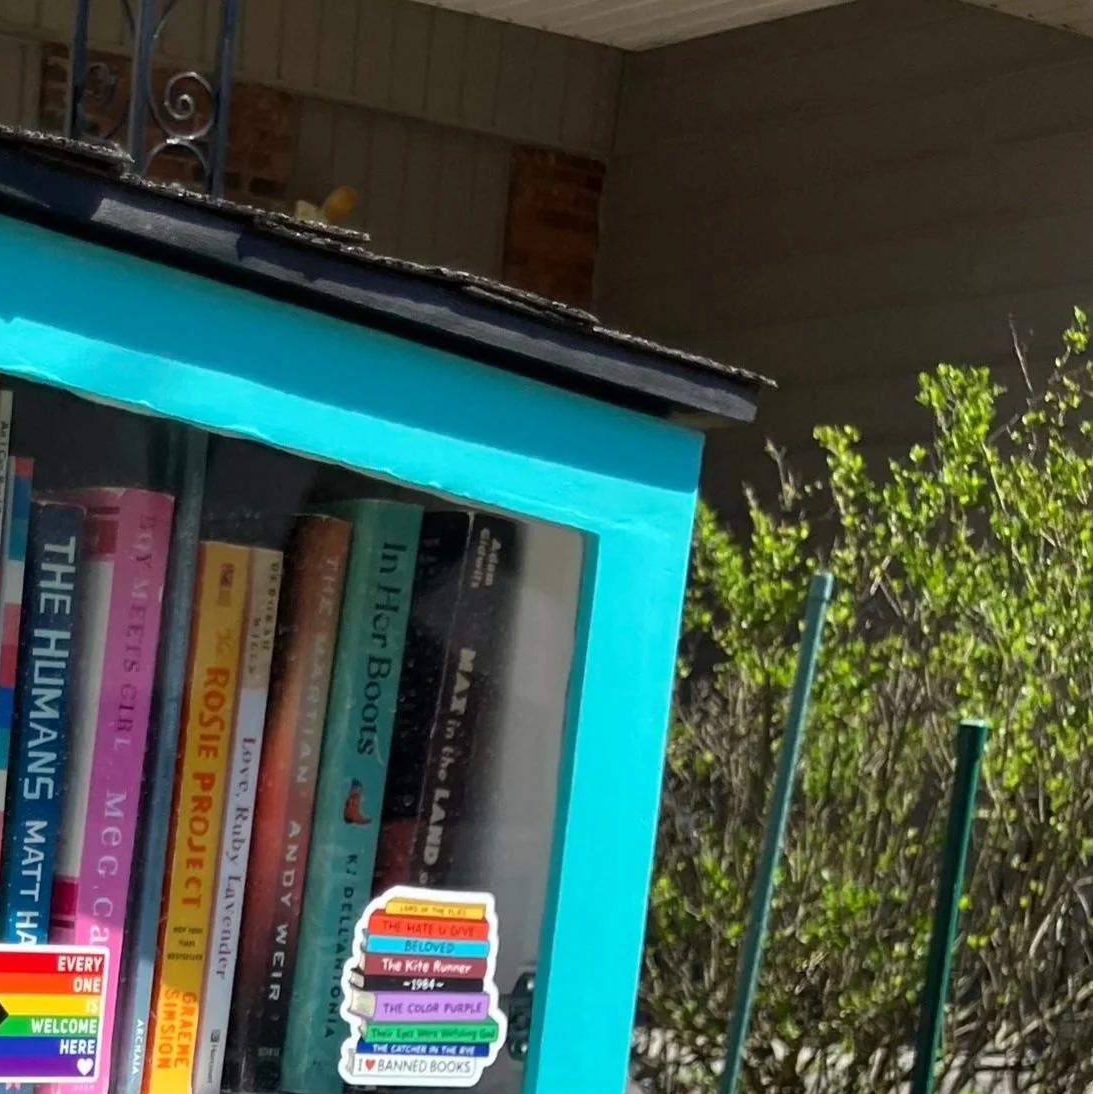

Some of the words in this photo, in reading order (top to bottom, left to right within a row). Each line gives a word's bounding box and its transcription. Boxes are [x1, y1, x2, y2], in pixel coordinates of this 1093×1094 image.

[131, 516, 157, 569] BOY
[379, 541, 408, 575] In
[40, 536, 77, 614] THE
[123, 578, 149, 673] MEETS
[371, 584, 402, 649] Her
[196, 667, 230, 758] ROSIE
[295, 633, 327, 784] MARTIAN
[449, 647, 476, 716] MAX
[22, 628, 72, 800] HUMANS
[113, 677, 137, 752] GIRL
[232, 736, 257, 798] Love,
[181, 771, 216, 909] PROJECT
[224, 806, 251, 867] Ruby
[423, 787, 451, 865] LAND
[19, 819, 48, 902] MATT
[280, 820, 302, 908] ANDY
[215, 875, 243, 981] Lavender
[383, 920, 401, 933] THE
[407, 921, 434, 935] HATE
[438, 924, 446, 935] U
[449, 924, 475, 938] GIVE
[404, 940, 455, 954] BELOVED
[58, 955, 103, 973] EVERY
[73, 977, 101, 993] ONE
[267, 923, 291, 1002] WEIR
[324, 886, 355, 1039] DELL'ANTONIA
[381, 957, 401, 971] The
[405, 957, 430, 973] Kite
[433, 960, 473, 974] Runner
[31, 1018, 98, 1034] WELCOME
[85, 999, 99, 1013] IS
[156, 987, 179, 1070] SIMSION
[174, 991, 198, 1069] GRAEME
[383, 1002, 405, 1013] THE
[407, 1002, 439, 1013] COLOR
[443, 1002, 483, 1014] PURPLE
[396, 1027, 415, 1040] Eyes
[59, 1039, 96, 1055] HERE
[130, 1018, 143, 1075] ARCHAIA
[357, 1058, 363, 1072] I
[377, 1058, 427, 1073] BANNED
[430, 1058, 472, 1073] BOOKS
[372, 1044, 388, 1054] THE
[390, 1044, 427, 1055] CATCHER
